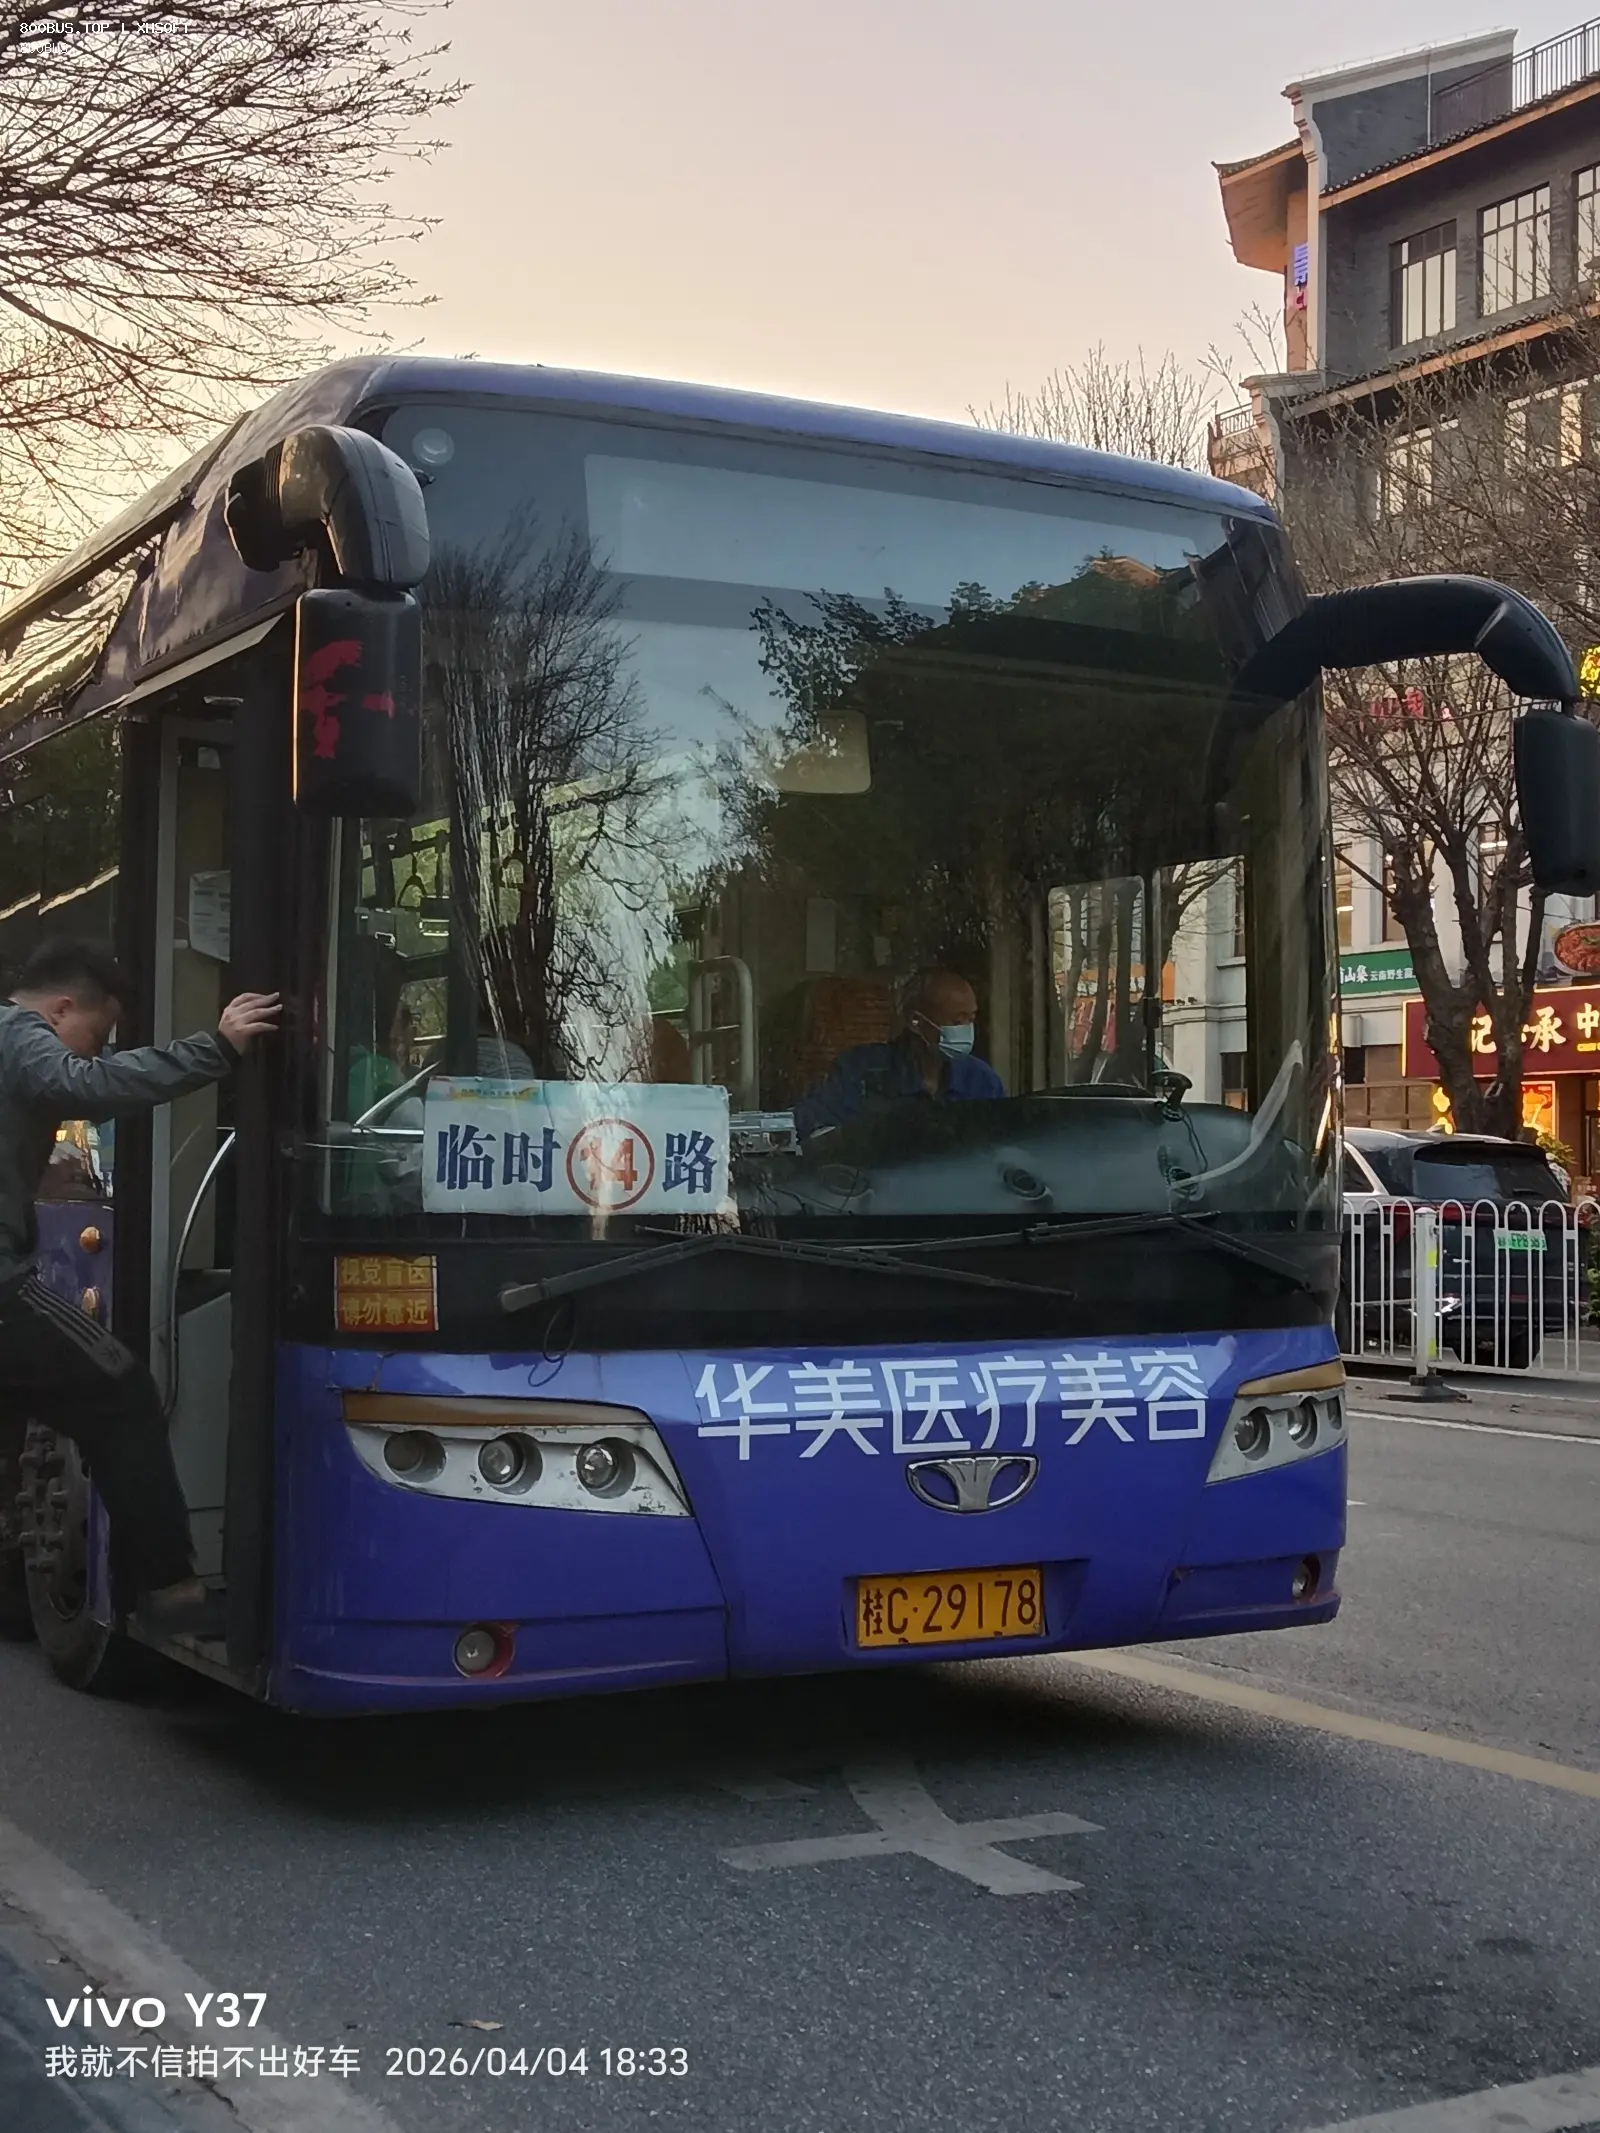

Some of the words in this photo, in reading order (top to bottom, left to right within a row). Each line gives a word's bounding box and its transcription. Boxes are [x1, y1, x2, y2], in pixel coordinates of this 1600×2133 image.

[695, 1350, 1208, 1461] 华美医疗美容
